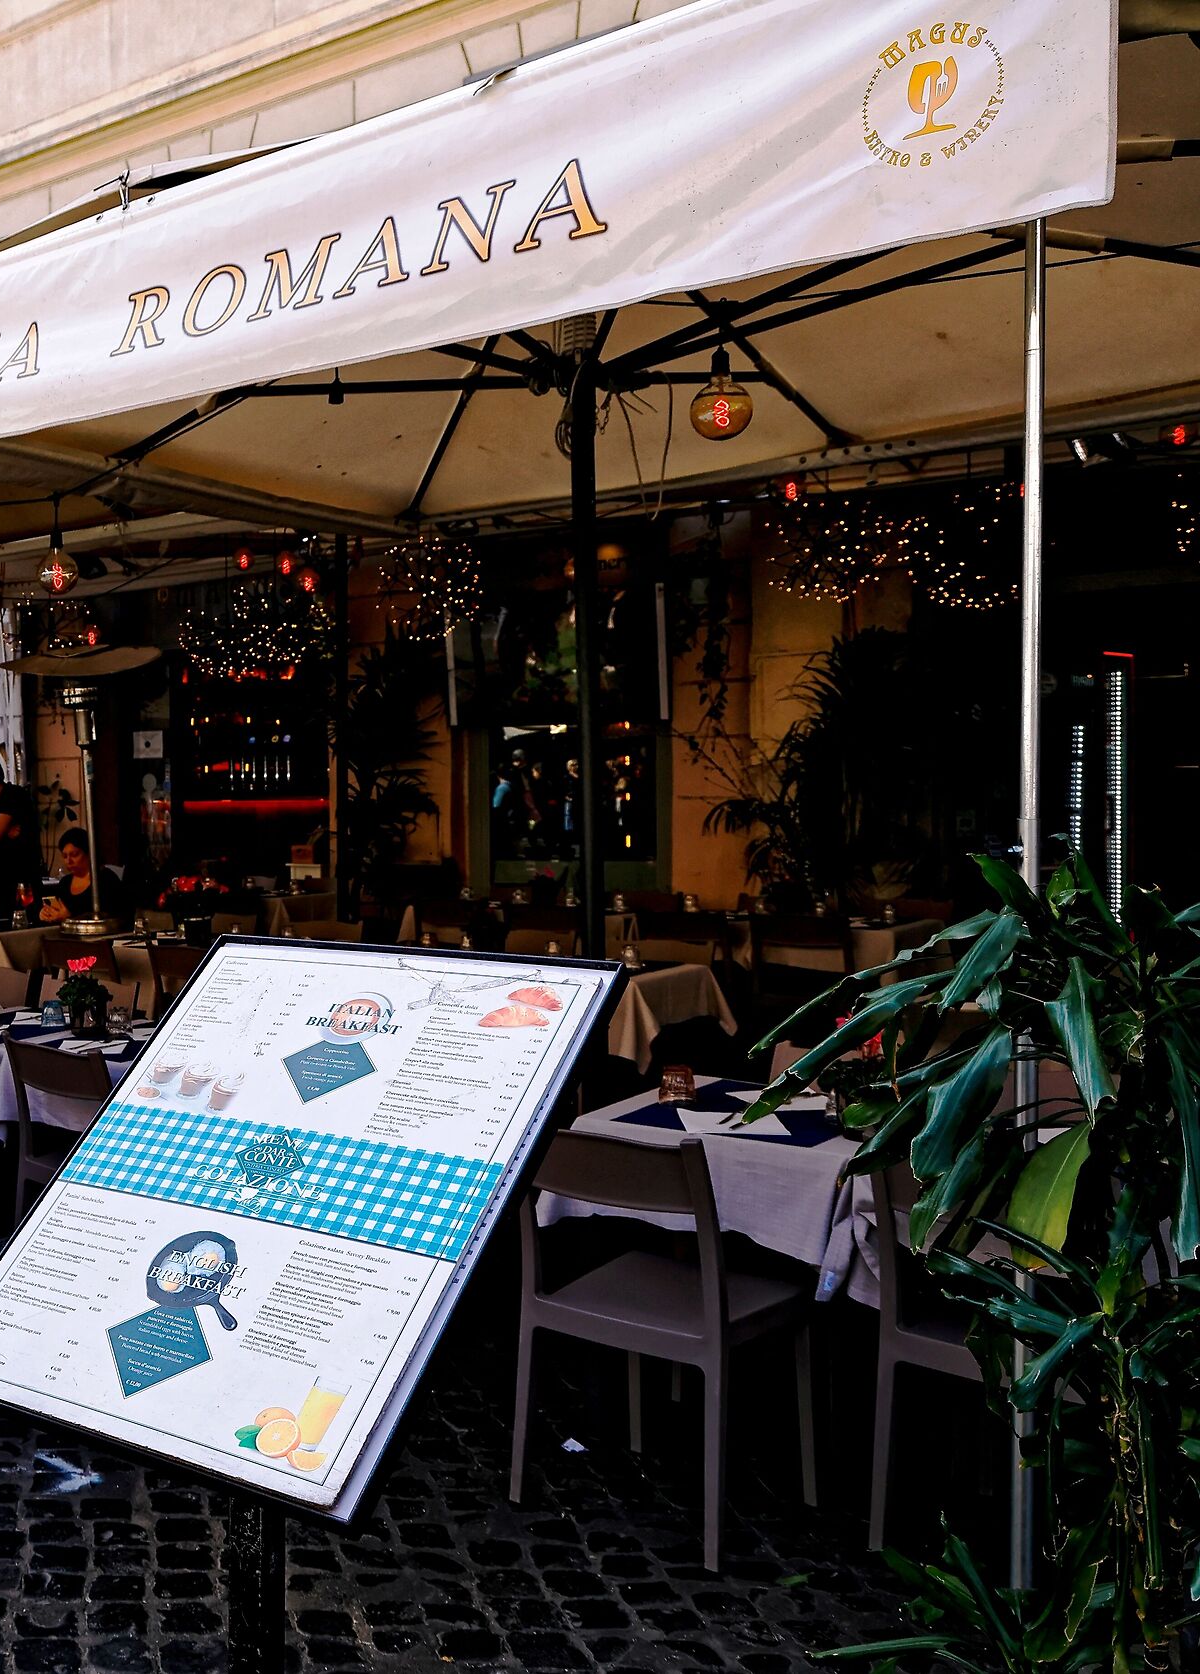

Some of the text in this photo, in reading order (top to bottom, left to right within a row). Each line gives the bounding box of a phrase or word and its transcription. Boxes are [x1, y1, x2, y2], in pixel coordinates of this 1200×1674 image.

[110, 156, 609, 358] ROMANA
[328, 1003, 396, 1020] ITALIAN
[305, 1016, 402, 1037] BREAKFAST
[252, 1133, 309, 1152] MENU
[263, 1145, 285, 1156] DAR
[244, 1150, 298, 1169] CONTE
[193, 1164, 324, 1200] COLAZIONE
[166, 1249, 249, 1279] ENGLISH
[147, 1266, 247, 1300] BREAKFAST
